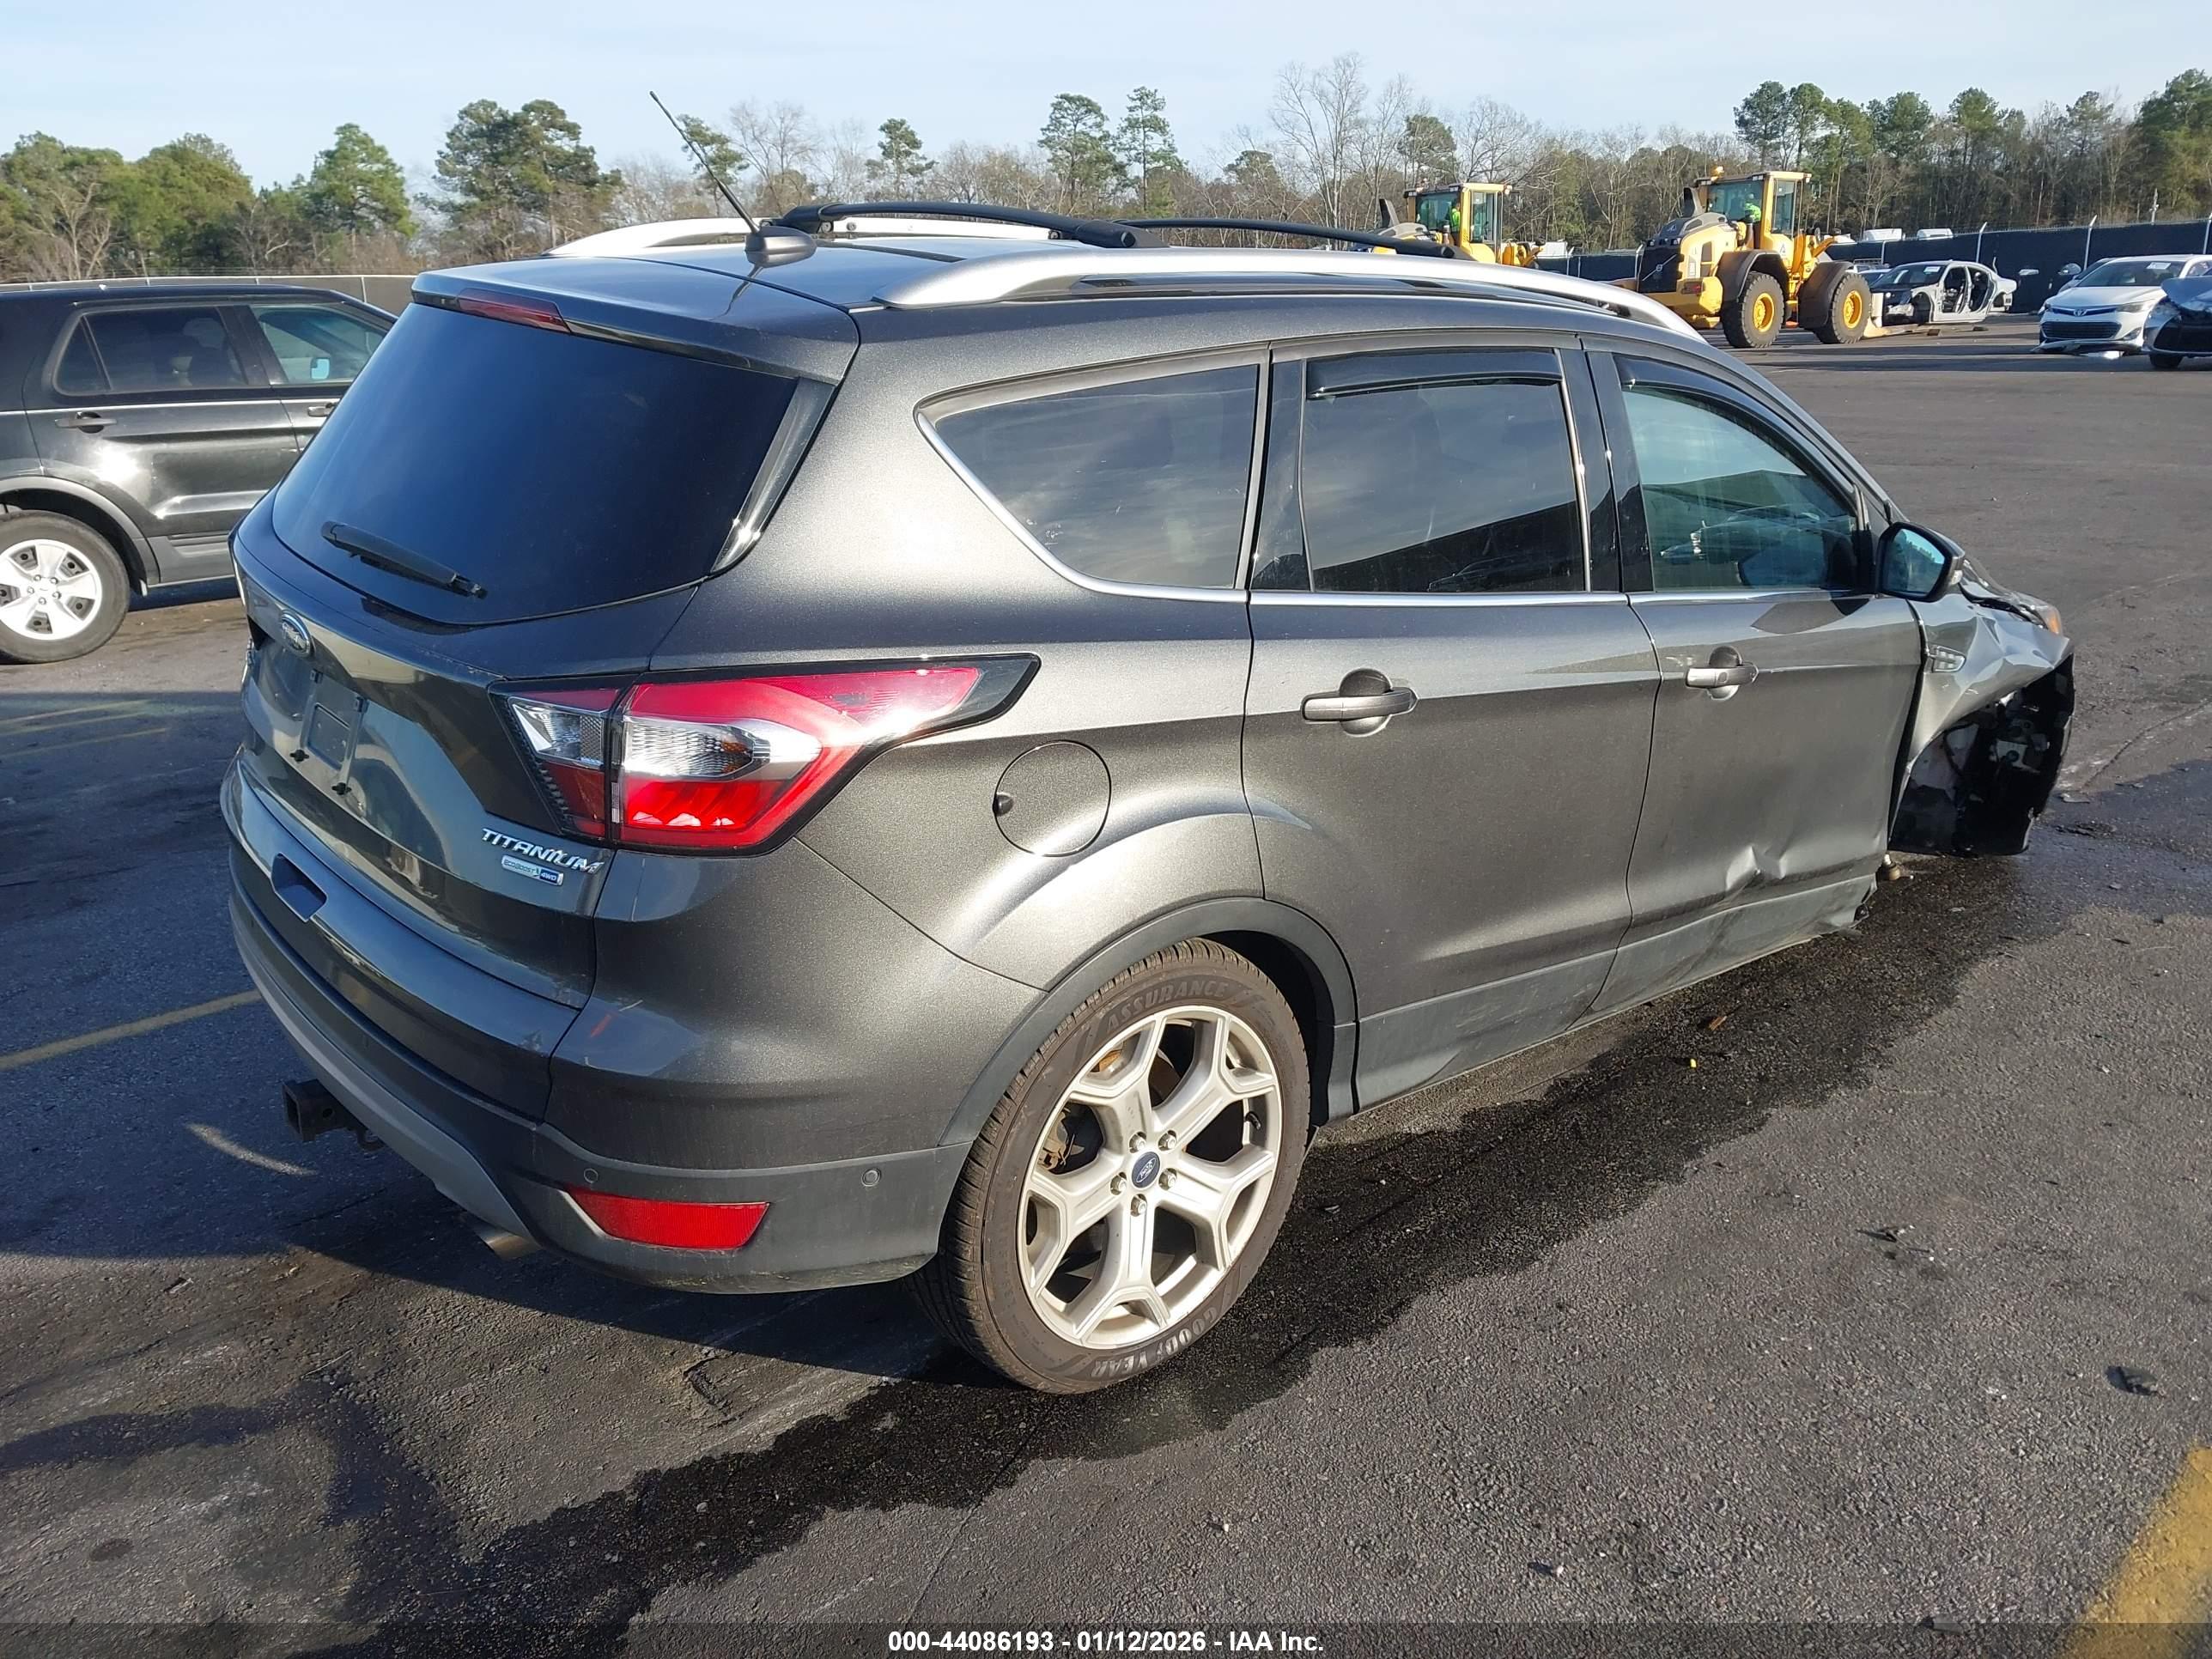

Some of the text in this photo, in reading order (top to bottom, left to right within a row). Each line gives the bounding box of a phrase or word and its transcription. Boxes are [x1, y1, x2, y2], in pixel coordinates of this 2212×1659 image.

[482, 829, 605, 873] TITANIUM
[540, 872, 557, 881] 4WD
[1108, 981, 1229, 1031] ASSURANCE
